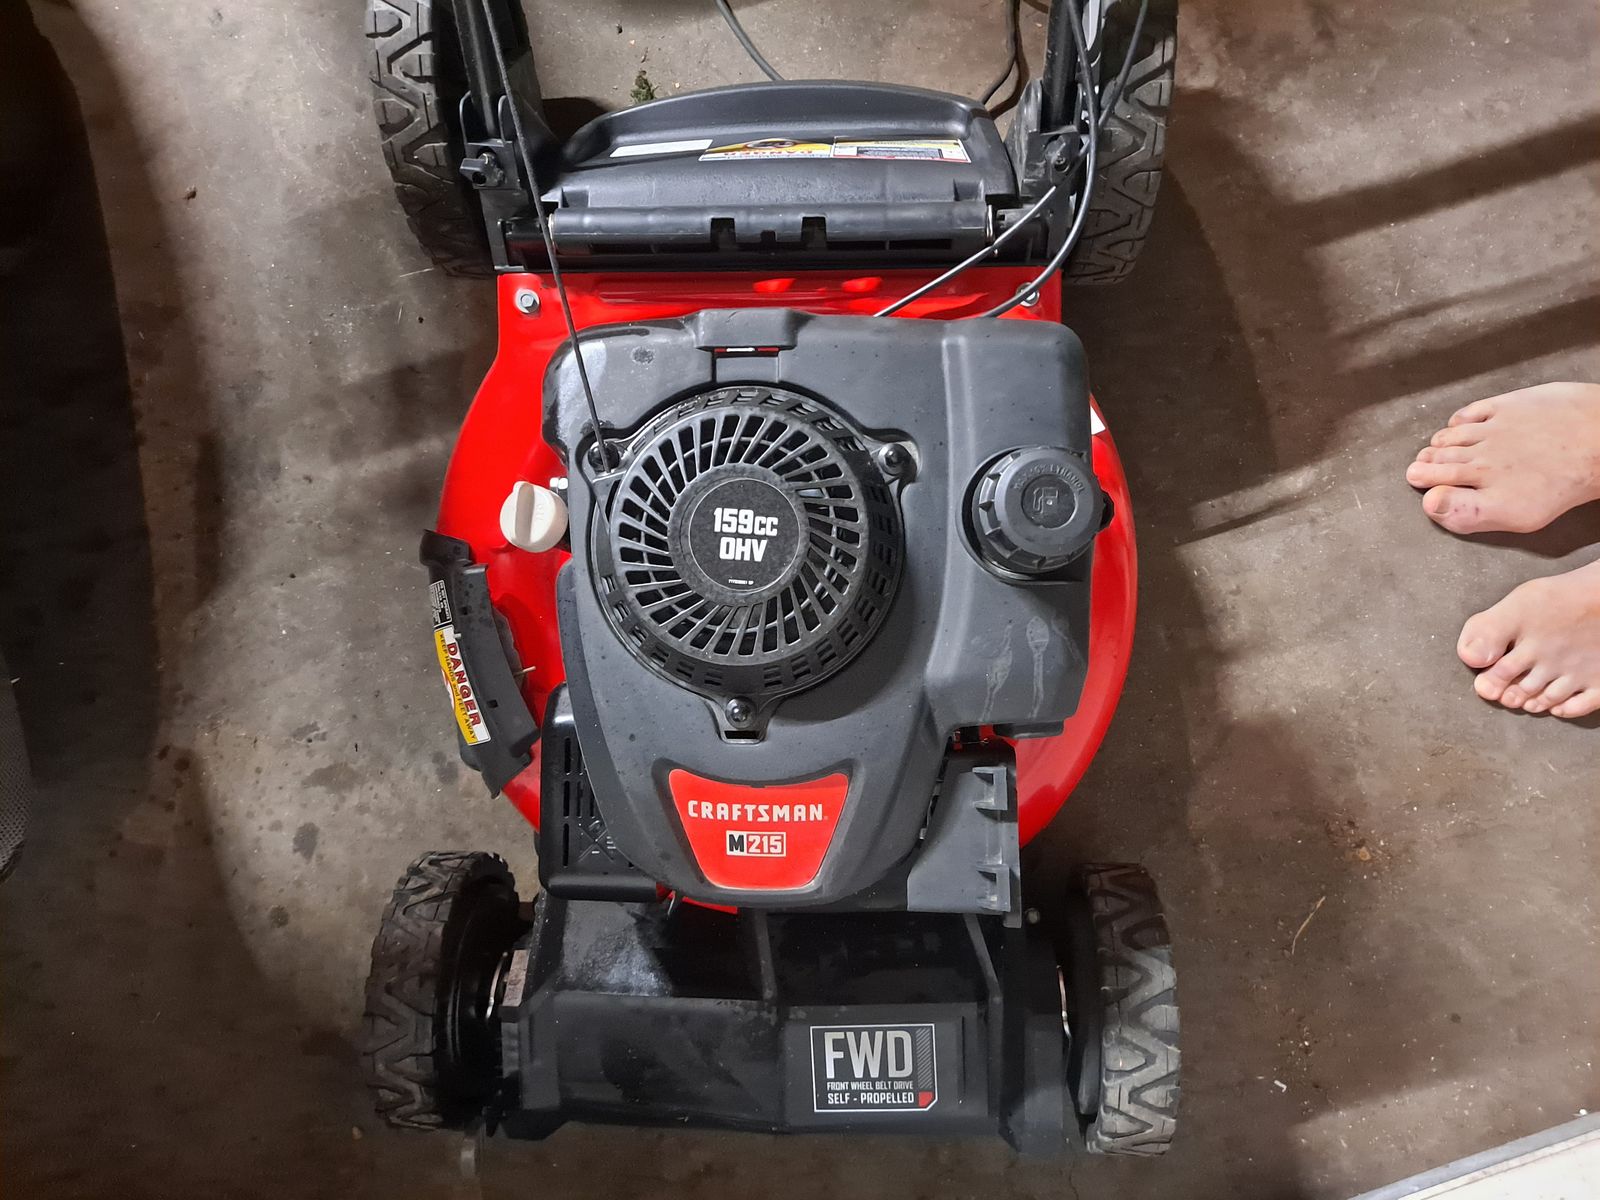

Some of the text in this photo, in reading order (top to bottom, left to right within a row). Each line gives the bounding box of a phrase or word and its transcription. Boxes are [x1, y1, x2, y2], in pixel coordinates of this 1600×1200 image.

[714, 507, 778, 536] 159cc
[719, 536, 768, 562] OHV
[439, 634, 448, 655] KEEP
[445, 655, 456, 682] HANDS
[457, 697, 467, 716] FEET
[464, 717, 476, 739] AWAY
[447, 641, 481, 726] DANGER
[687, 799, 823, 822] CRAFTSMAN
[824, 1030, 913, 1079] FWD
[826, 1080, 914, 1091] FRONT WHEEL BELT DRIVE
[827, 1092, 850, 1104] SELF
[860, 1091, 915, 1104] PROPELLED
